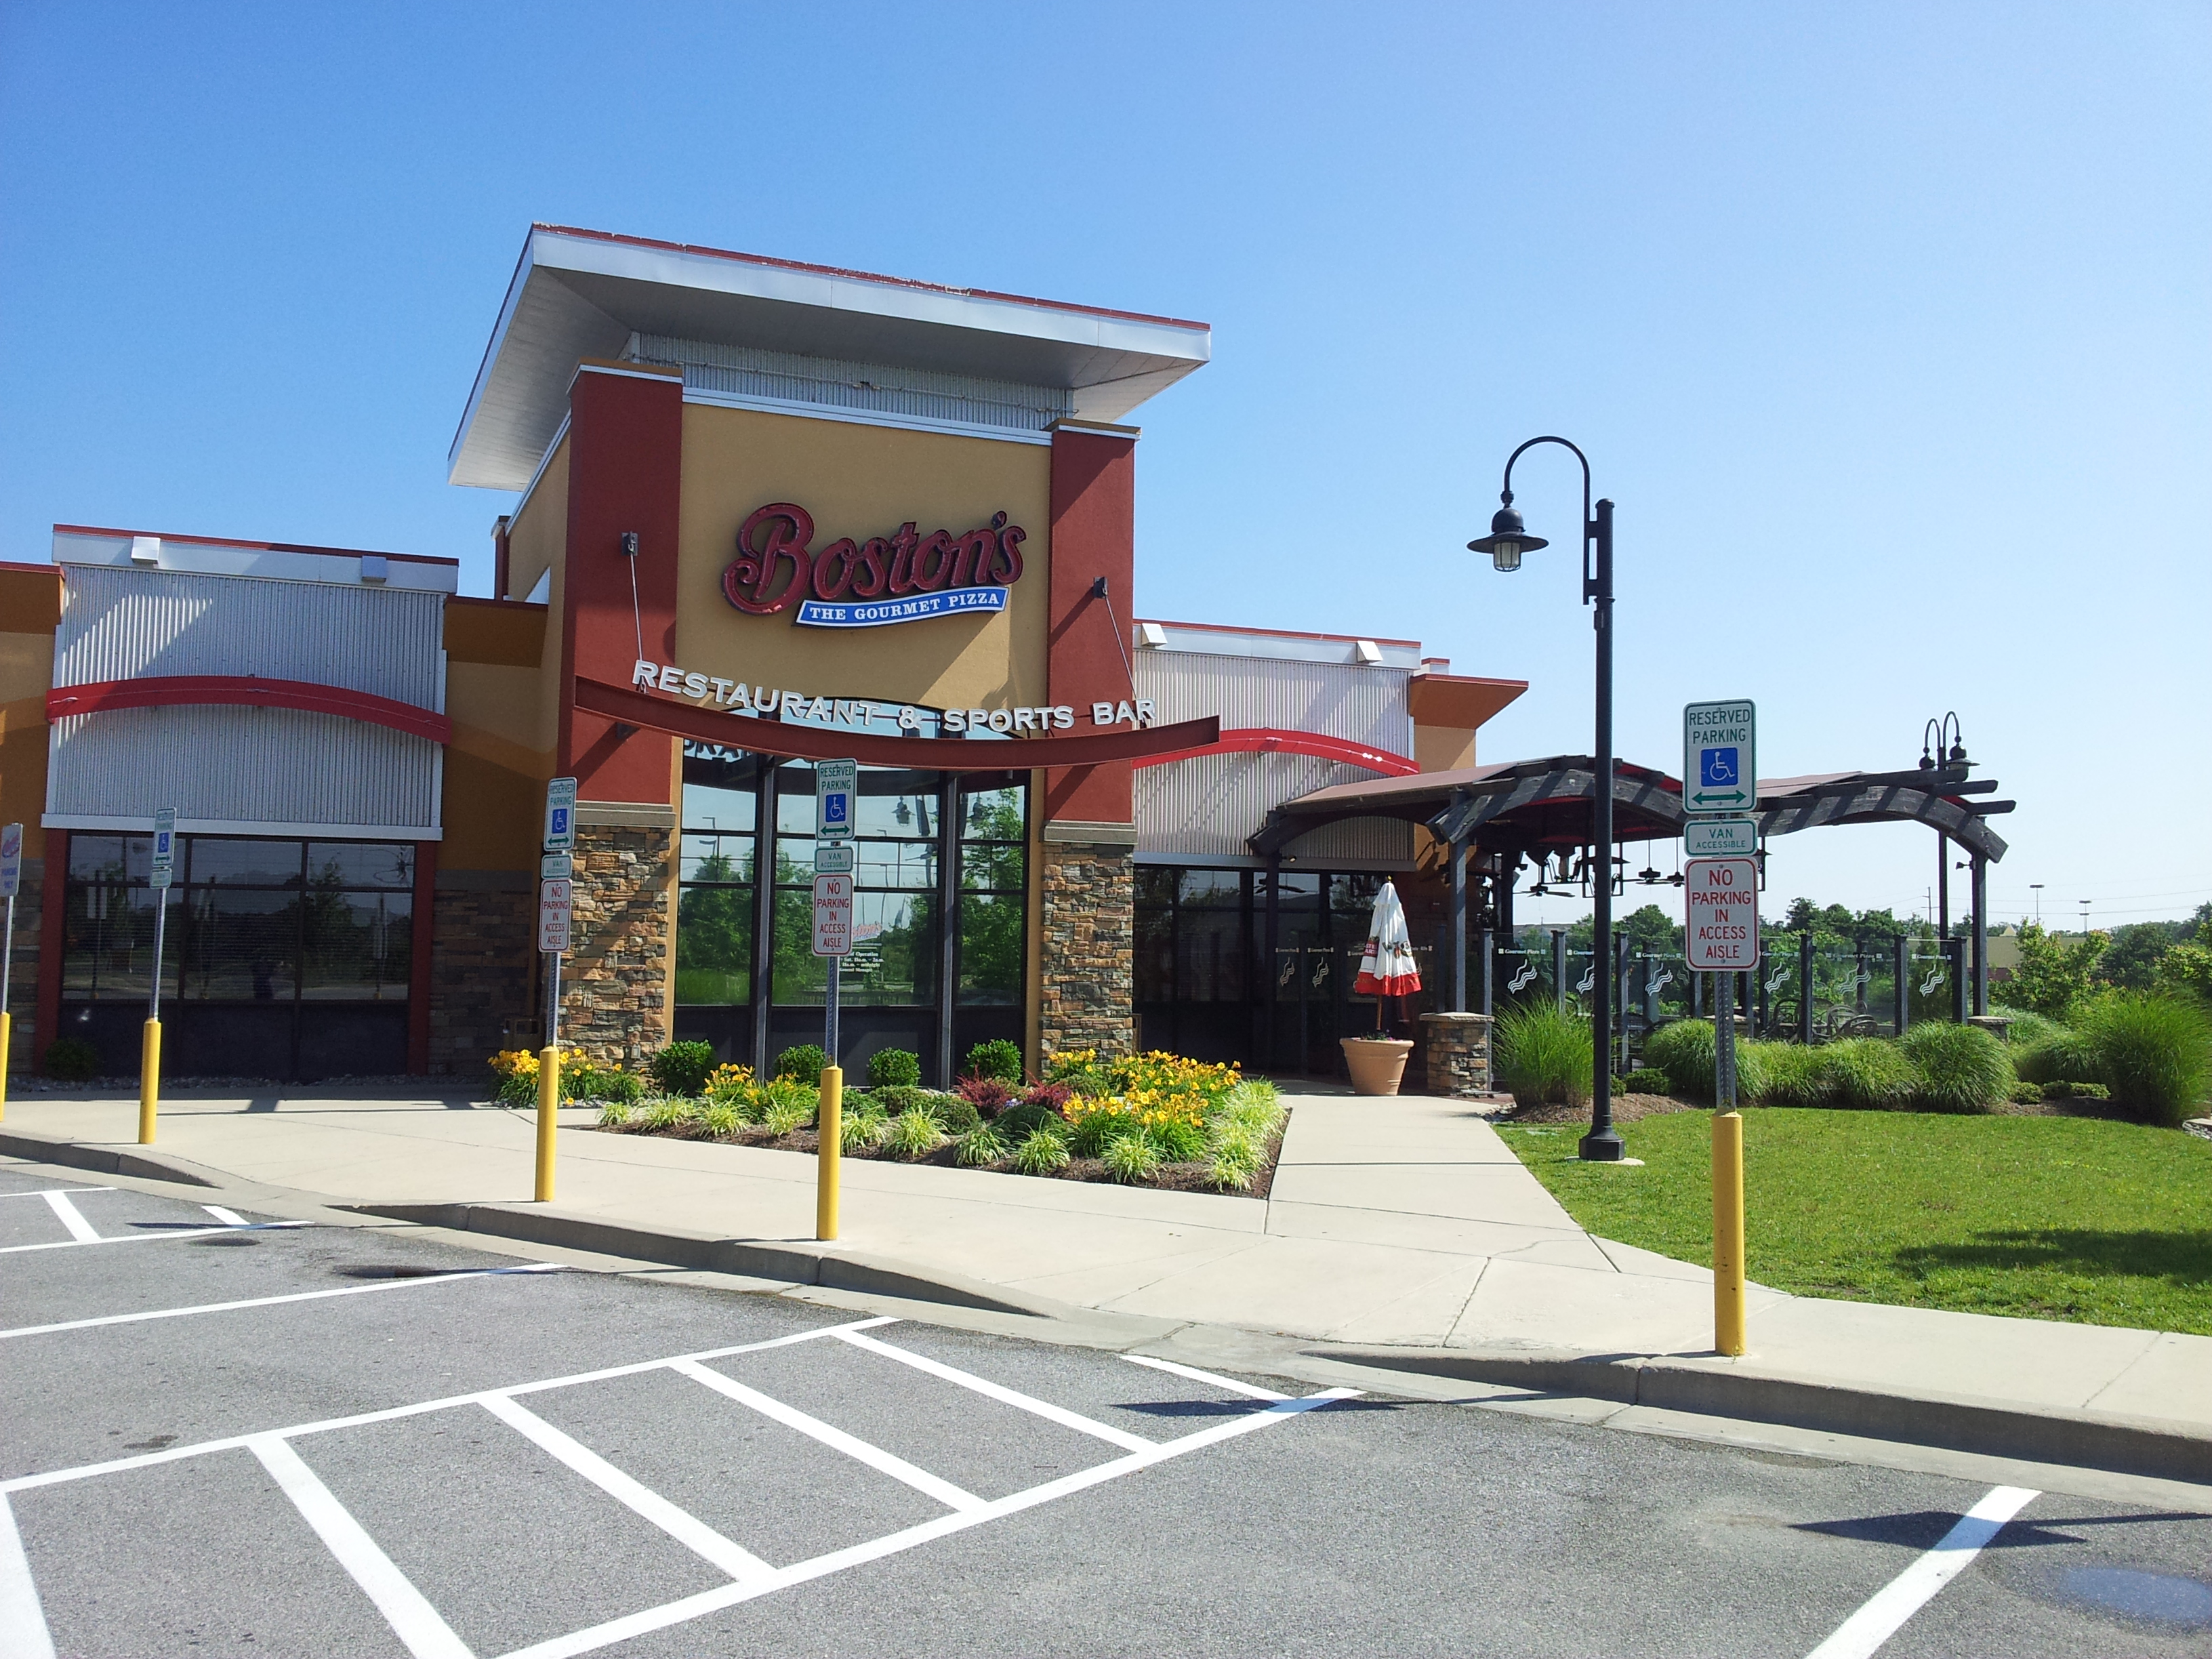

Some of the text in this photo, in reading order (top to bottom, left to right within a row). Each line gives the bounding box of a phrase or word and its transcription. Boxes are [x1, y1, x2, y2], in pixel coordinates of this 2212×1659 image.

[722, 501, 1026, 615] Boston's
[810, 592, 1000, 620] THE GOURMET PIZZA
[632, 659, 1156, 732] RESTAURANT & SPORTS BAR
[1689, 709, 1750, 726] RESERVED
[1693, 728, 1746, 744] PARKING
[820, 766, 853, 779] RESERVED
[821, 780, 851, 792] PARKING
[550, 796, 571, 805] PARKING
[1709, 828, 1733, 839] VAN
[1696, 840, 1746, 848] ACCESSIBLE
[1709, 869, 1734, 886] NO
[552, 886, 562, 897] NO
[827, 882, 840, 895] NO
[817, 898, 849, 909] PARKING
[1692, 890, 1751, 905] PARKING
[544, 901, 568, 909] PARKING
[552, 912, 559, 921] IN
[829, 911, 837, 921] IN
[1715, 909, 1728, 922] IN
[545, 923, 565, 933] ACCESS
[819, 923, 846, 934] ACCESS
[1698, 926, 1746, 940] ACCESS
[547, 935, 562, 945] AISLE
[823, 937, 842, 947] AISLE
[1706, 945, 1740, 959] AISLE
